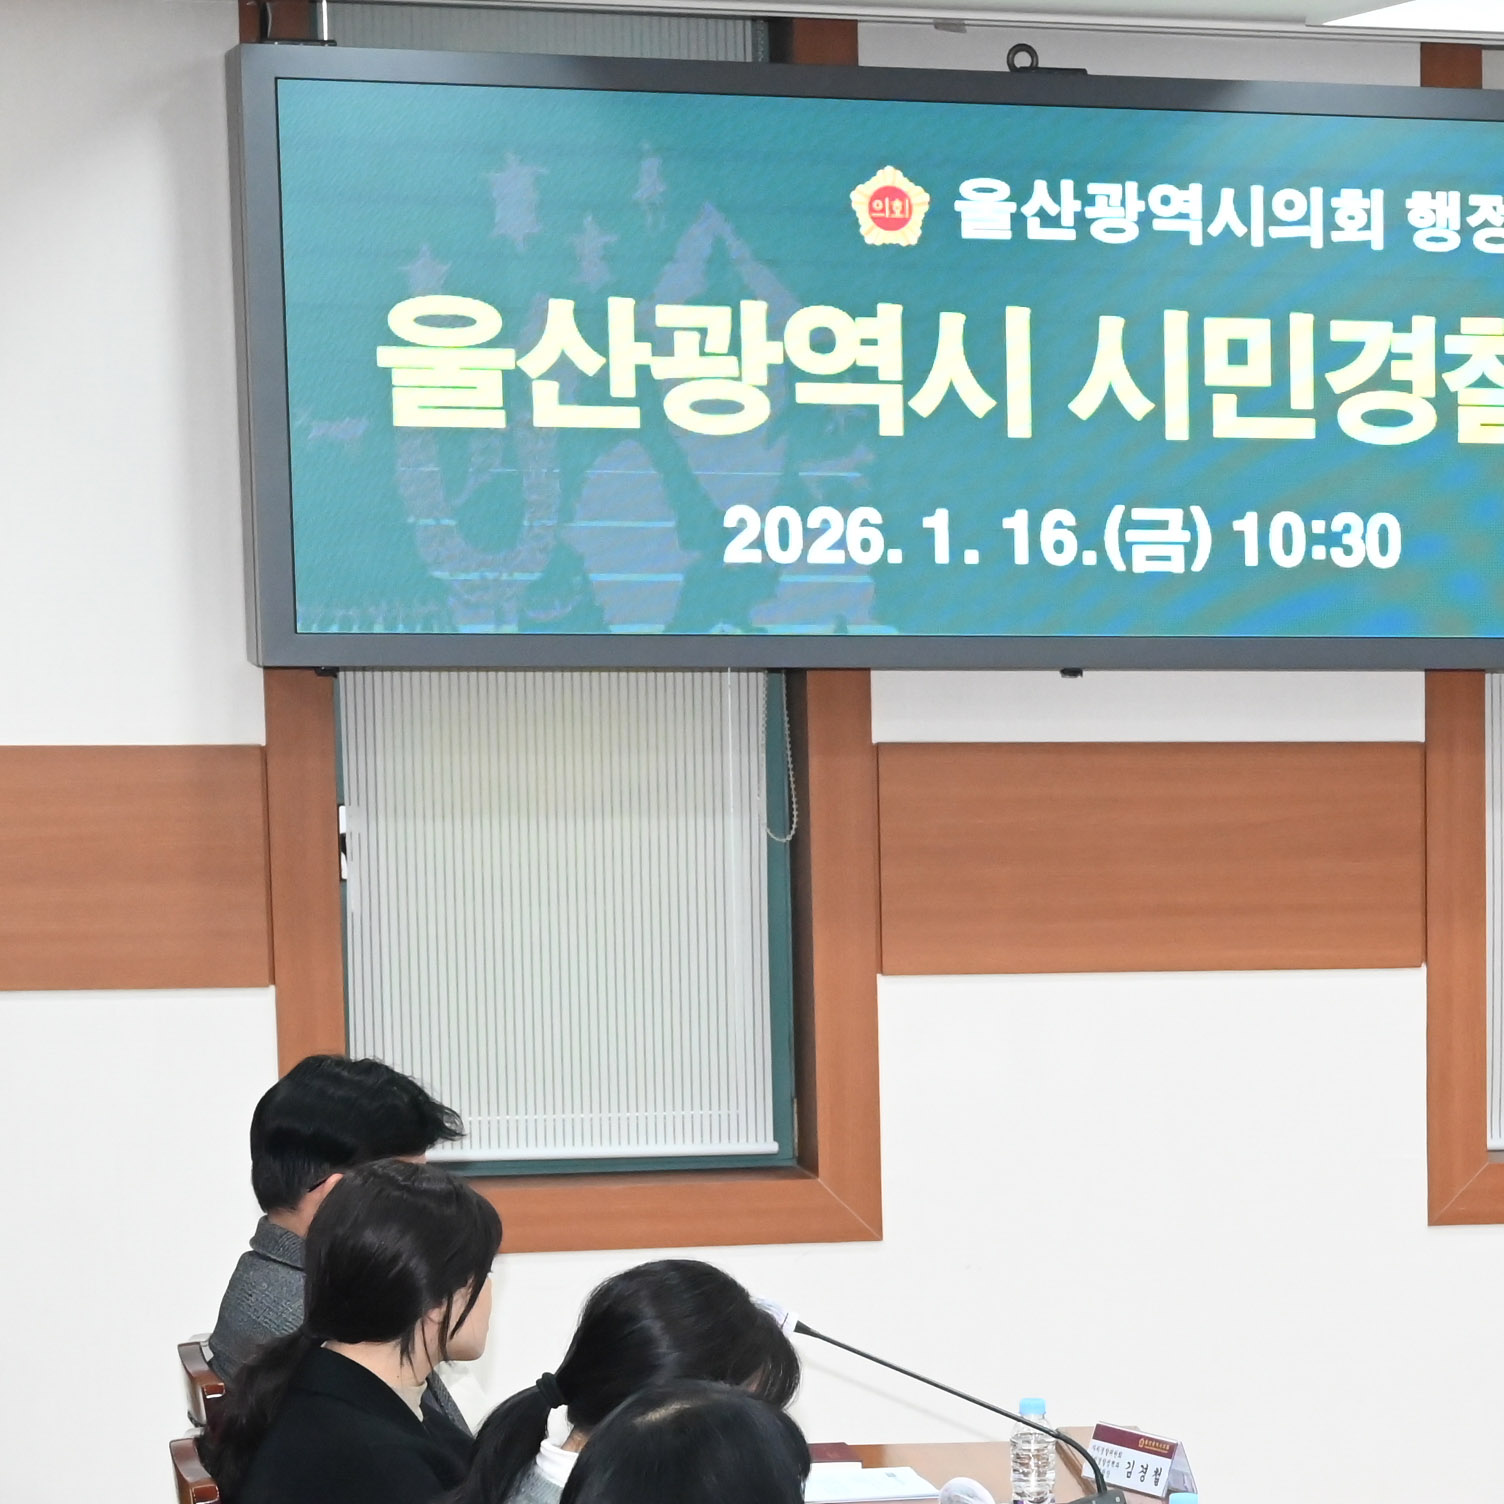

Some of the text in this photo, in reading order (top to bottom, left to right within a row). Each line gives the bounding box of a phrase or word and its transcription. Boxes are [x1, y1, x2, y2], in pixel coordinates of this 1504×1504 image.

[872, 197, 910, 219] 의회
[955, 177, 1383, 250] 울산광역시의회
[376, 294, 1031, 439] 울산광역시
[723, 504, 1402, 574] 2026. 1. 16.(금) 10:30
